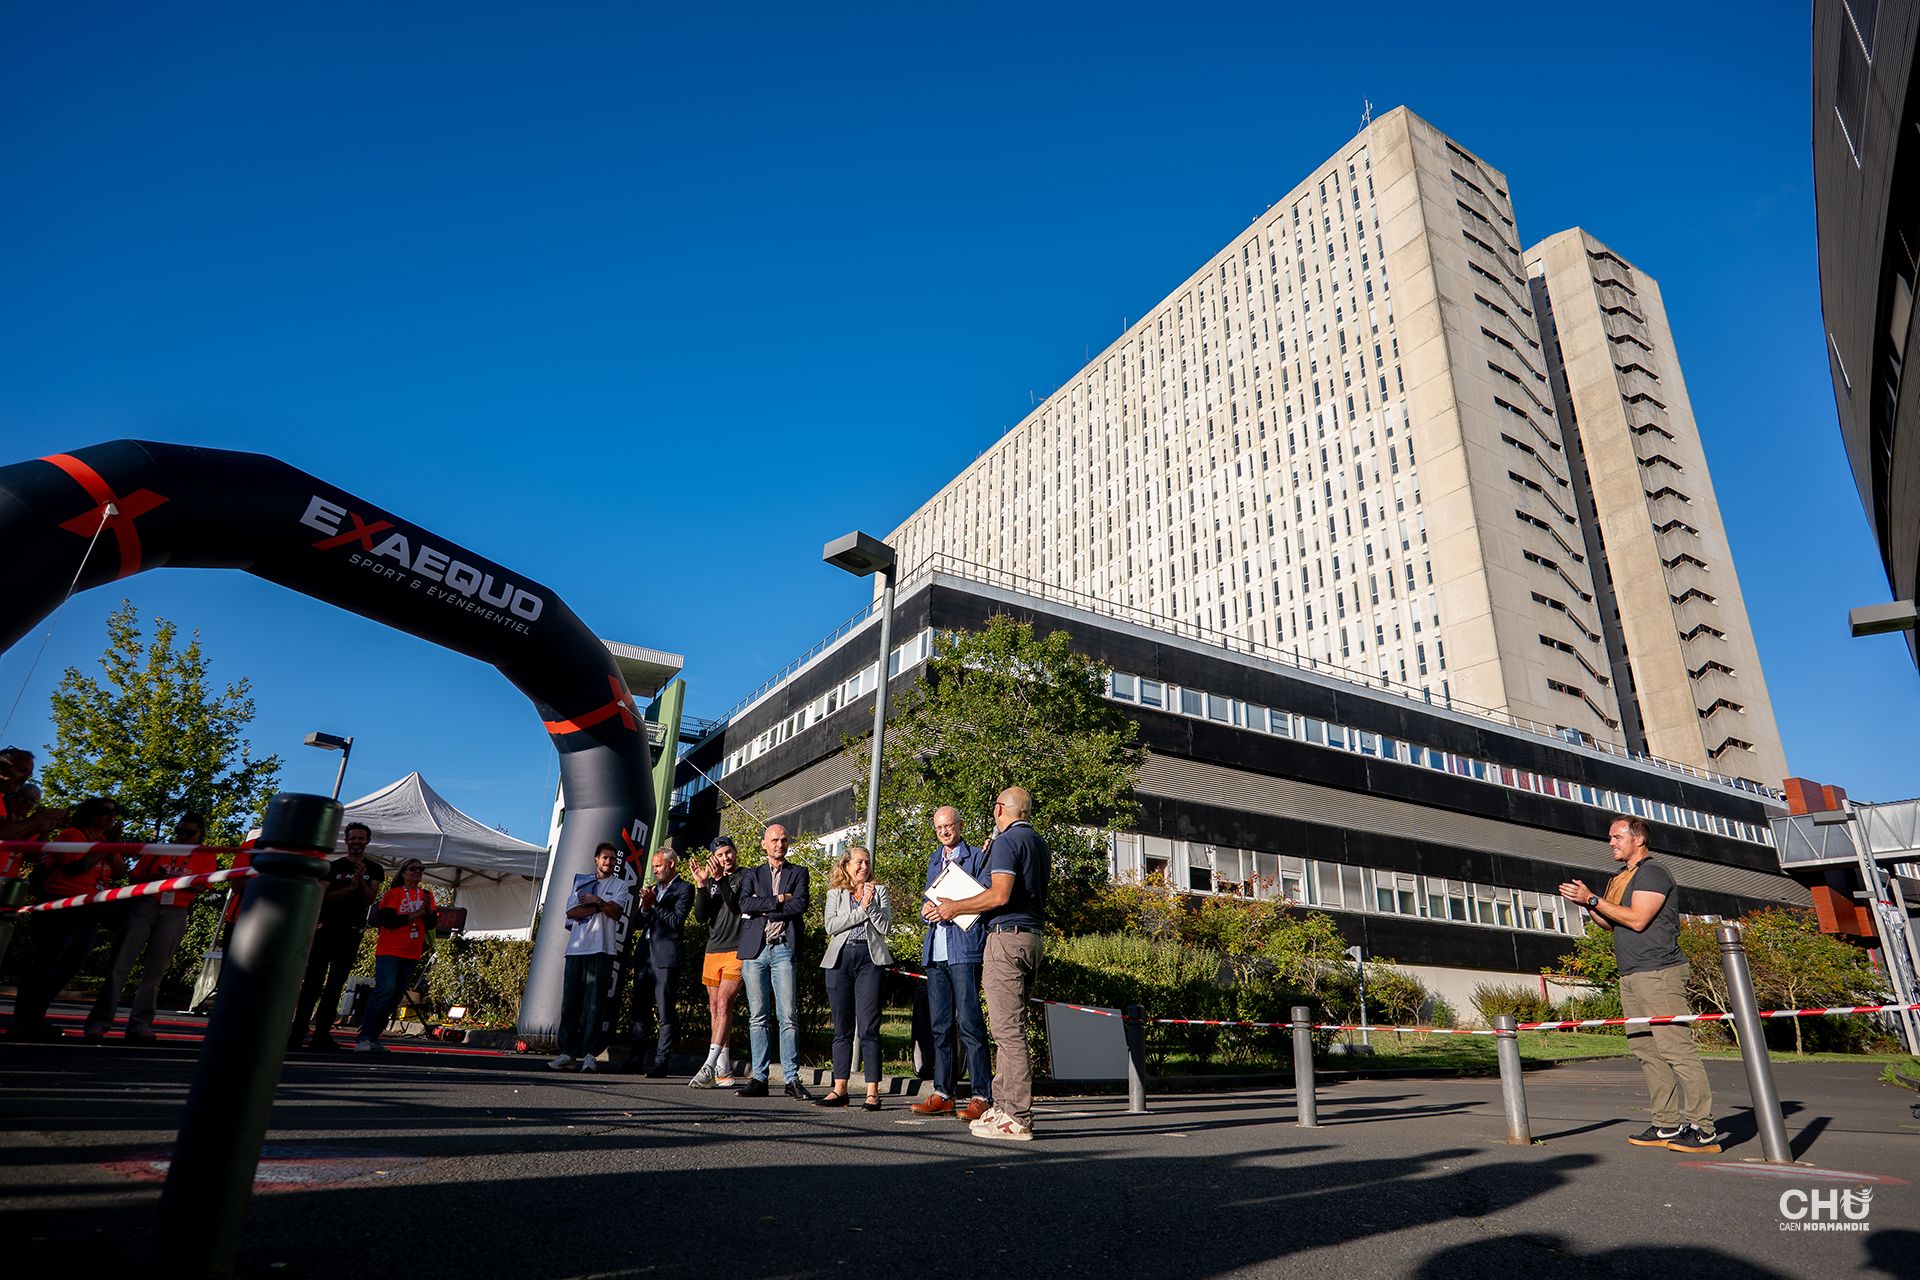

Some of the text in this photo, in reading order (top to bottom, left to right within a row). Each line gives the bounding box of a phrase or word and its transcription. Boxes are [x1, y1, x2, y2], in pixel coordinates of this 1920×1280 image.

[300, 495, 544, 622] EXAEQUO
[349, 553, 530, 635] SPORT & ÉVÉNEMENTIEL
